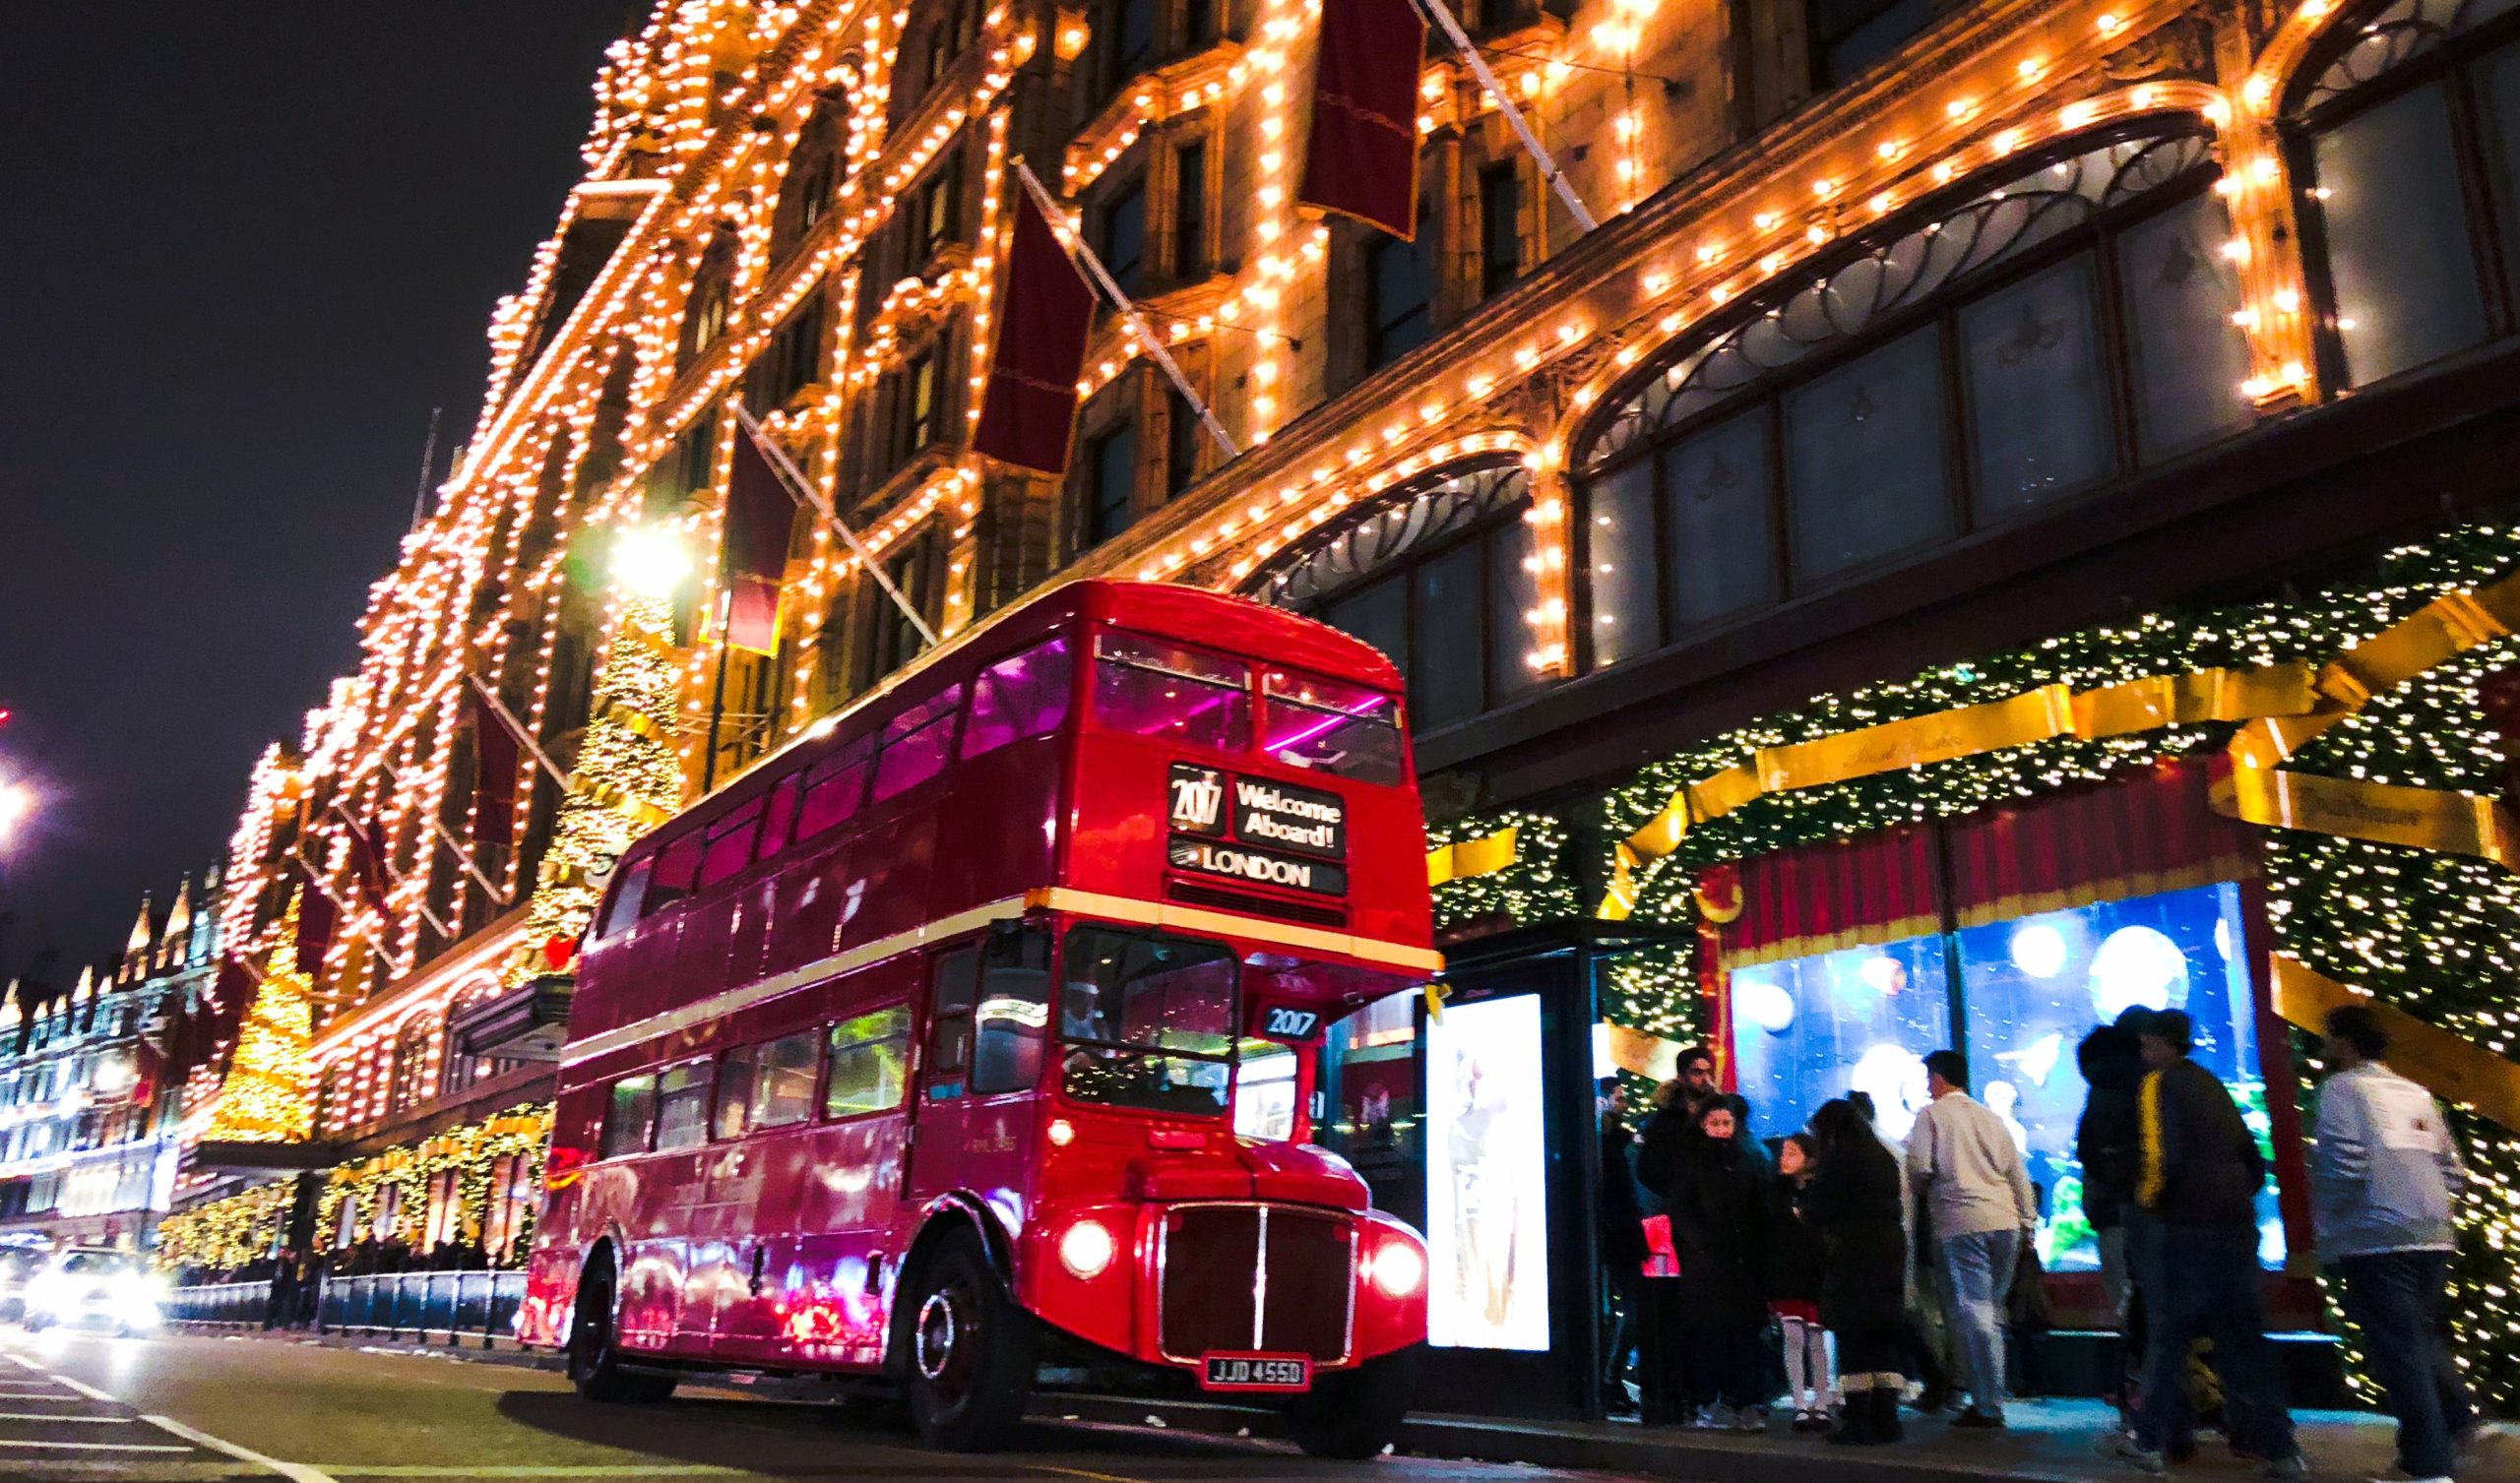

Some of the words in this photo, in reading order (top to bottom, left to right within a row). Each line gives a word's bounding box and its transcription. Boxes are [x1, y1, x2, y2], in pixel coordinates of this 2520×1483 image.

[1235, 781, 1342, 823] Welcome
[1244, 812, 1335, 848] Aboard!
[1202, 846, 1311, 887] LONDON
[1268, 1008, 1317, 1035] 2017
